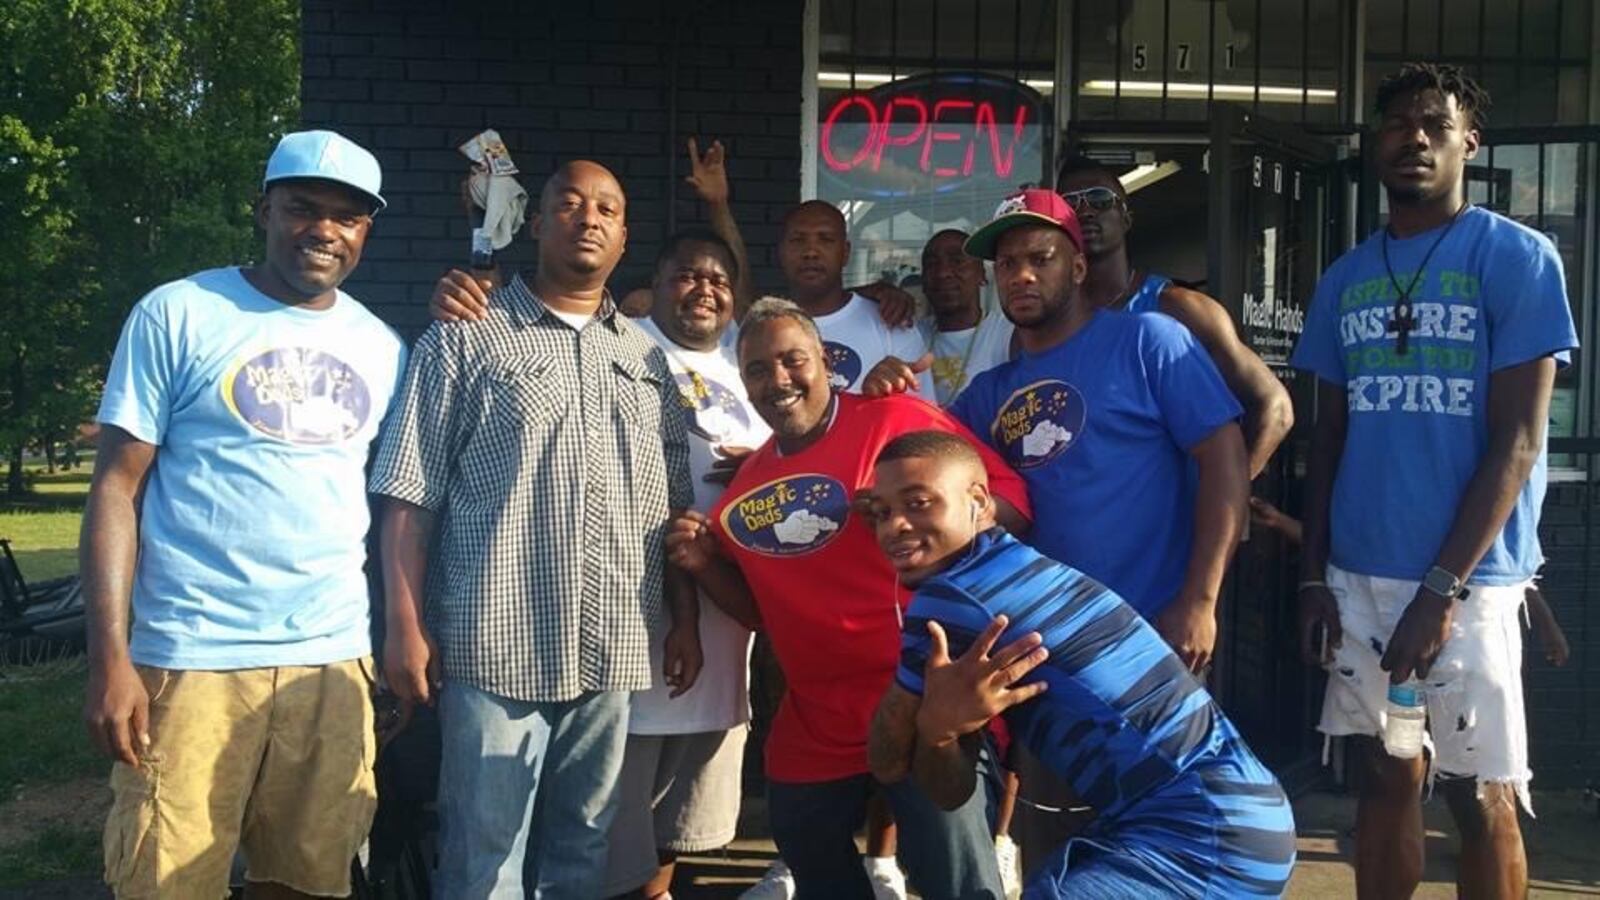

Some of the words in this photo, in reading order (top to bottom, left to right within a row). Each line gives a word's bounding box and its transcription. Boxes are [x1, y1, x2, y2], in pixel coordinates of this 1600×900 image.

[820, 95, 1029, 178] OPEN
[1275, 299, 1304, 334] Hands
[740, 483, 797, 518] Magic
[744, 508, 783, 532] Dads
